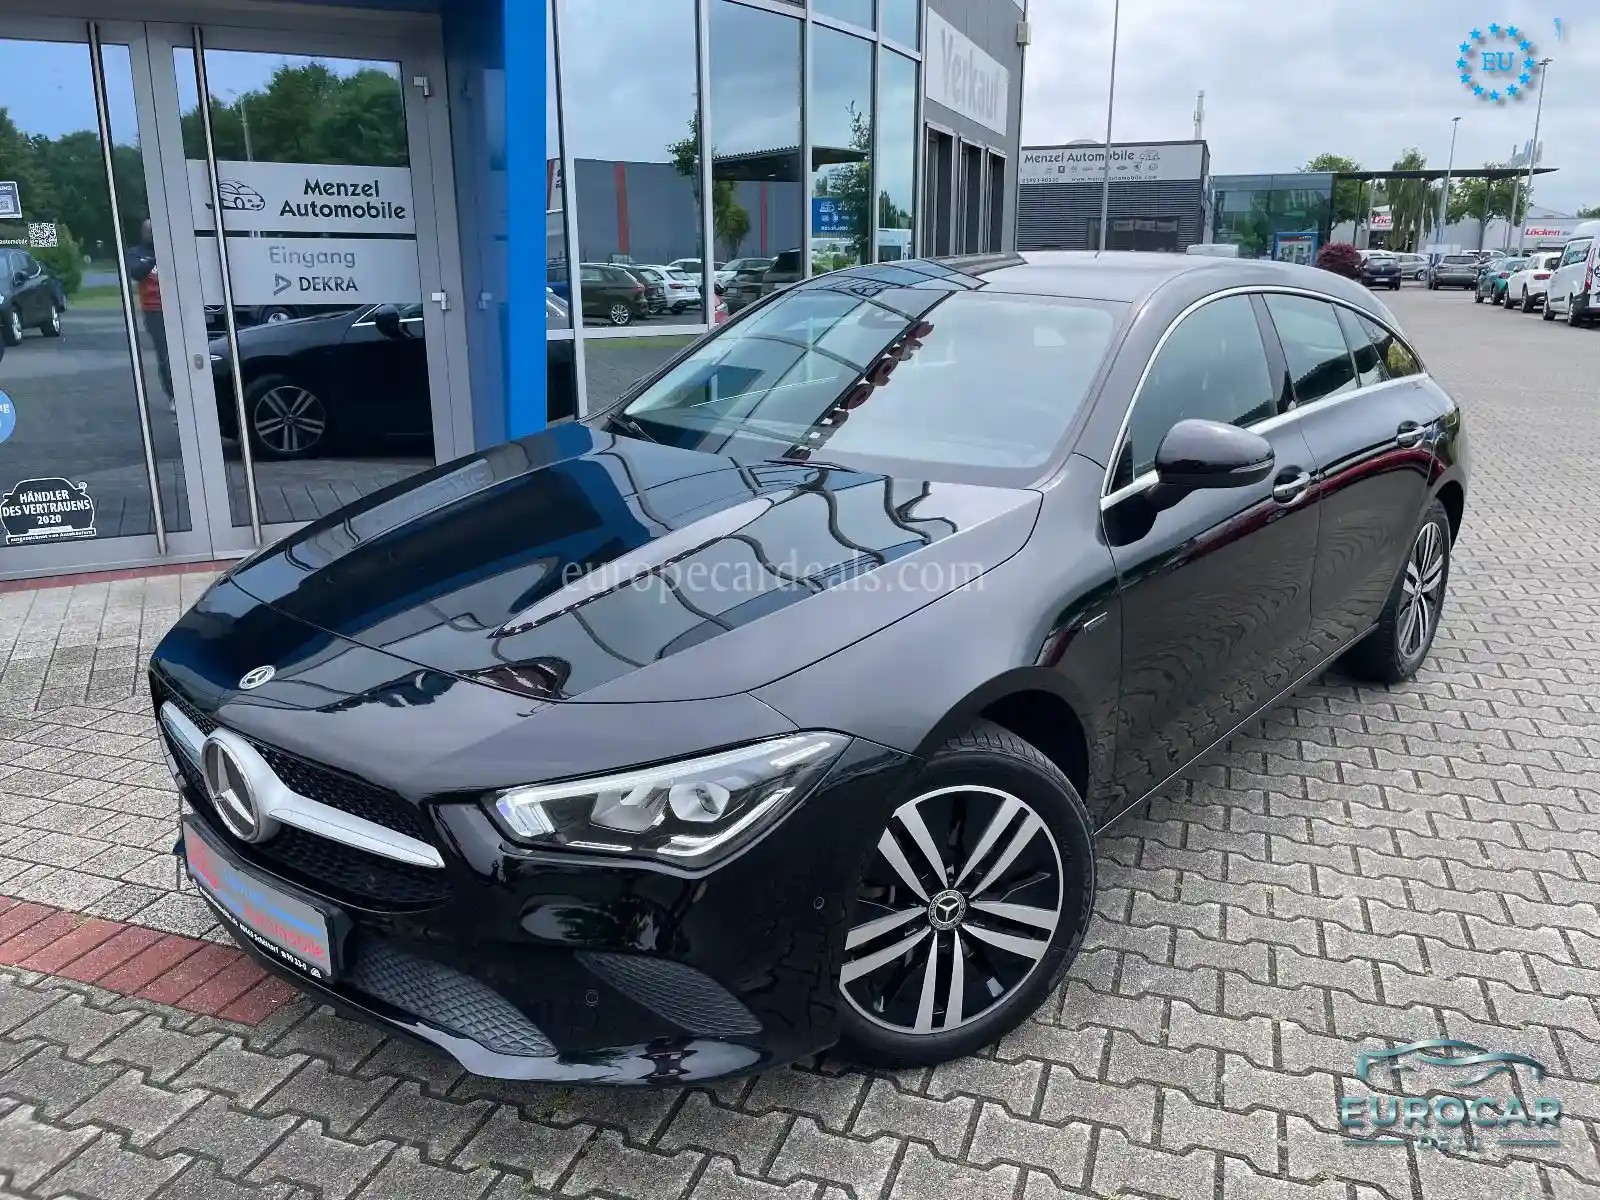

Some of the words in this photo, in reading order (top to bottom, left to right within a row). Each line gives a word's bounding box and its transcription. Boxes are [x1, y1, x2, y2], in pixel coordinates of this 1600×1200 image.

[941, 28, 1002, 120] Verkauf
[1024, 152, 1064, 163] Menzel
[303, 178, 380, 197] Menzel
[279, 200, 406, 219] Automobile
[268, 245, 356, 268] Eingang
[298, 276, 359, 292] DEKRA
[19, 489, 70, 503] HÄNDLER
[2, 505, 22, 517] DES
[22, 499, 91, 514] VERTRAUENS
[37, 514, 62, 525] 2020
